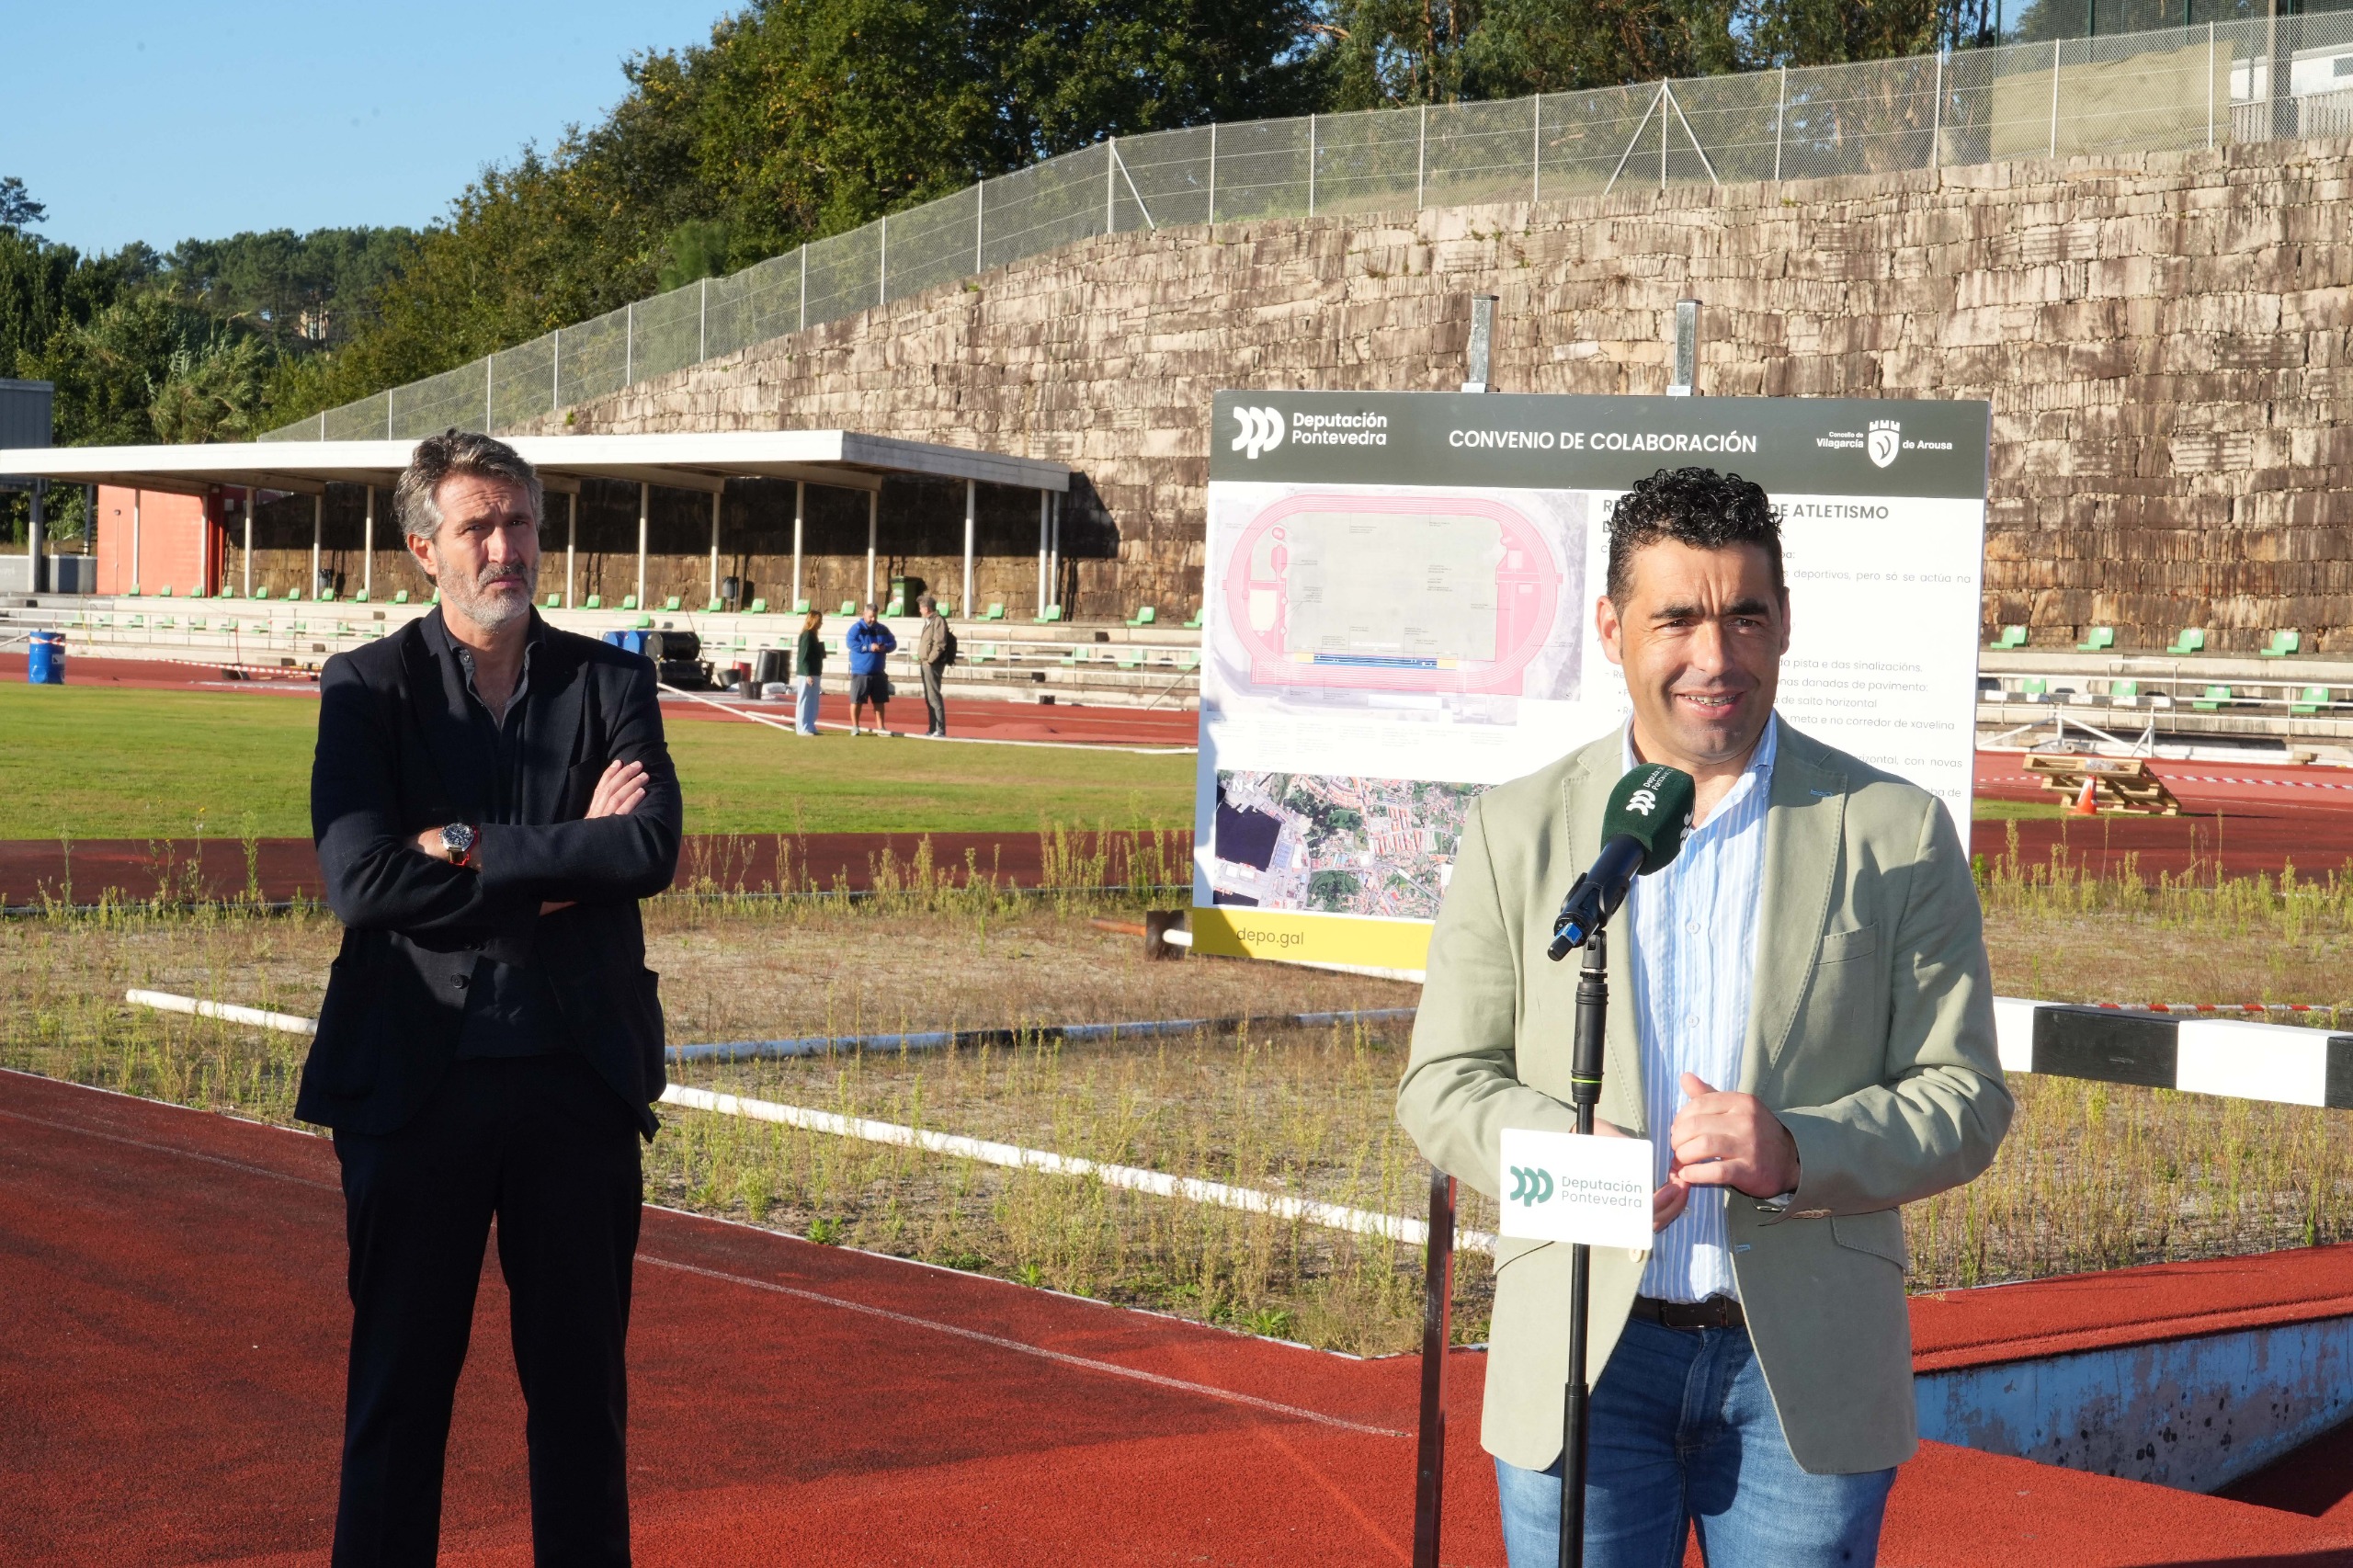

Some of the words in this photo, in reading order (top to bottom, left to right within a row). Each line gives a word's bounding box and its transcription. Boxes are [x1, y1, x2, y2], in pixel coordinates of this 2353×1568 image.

[1292, 411, 1388, 430] Deputación
[1291, 429, 1387, 447] Pontevedra
[1449, 430, 1554, 449] CONVENIO
[1561, 433, 1584, 449] DE
[1590, 430, 1756, 452] COLABORACIÓN
[1815, 437, 1864, 449] Vilagarcía
[1903, 440, 1915, 449] de
[1917, 440, 1952, 449] Arousa
[1792, 504, 1889, 520] ATLETISMO
[1793, 569, 1851, 581] deportivos,
[1856, 572, 1881, 582] pero
[1885, 573, 1898, 581] só
[1903, 574, 1915, 582] se
[1919, 573, 1951, 583] actúa
[1957, 575, 1972, 584] na
[1792, 659, 1819, 669] pista
[1821, 661, 1828, 669] e
[1830, 659, 1851, 669] das
[1853, 661, 1922, 673] sinalizacións.
[1802, 677, 1849, 688] danadas
[1851, 680, 1866, 689] de
[1868, 681, 1928, 692] pavimento:
[1780, 695, 1795, 705] de
[1797, 697, 1824, 706] salto
[1825, 698, 1877, 708] horizontal
[1790, 715, 1818, 724] meta
[1830, 717, 1844, 725] no
[1846, 718, 1892, 727] corredor
[1893, 718, 1908, 728] de
[1910, 720, 1955, 731] xavelina
[1904, 757, 1925, 766] con
[1930, 758, 1963, 768] novas
[1232, 778, 1244, 794] N
[1947, 788, 1961, 798] de
[1235, 926, 1304, 949] depo.gal
[1562, 1176, 1643, 1194] Deputación
[1562, 1190, 1643, 1208] Pontevedra
